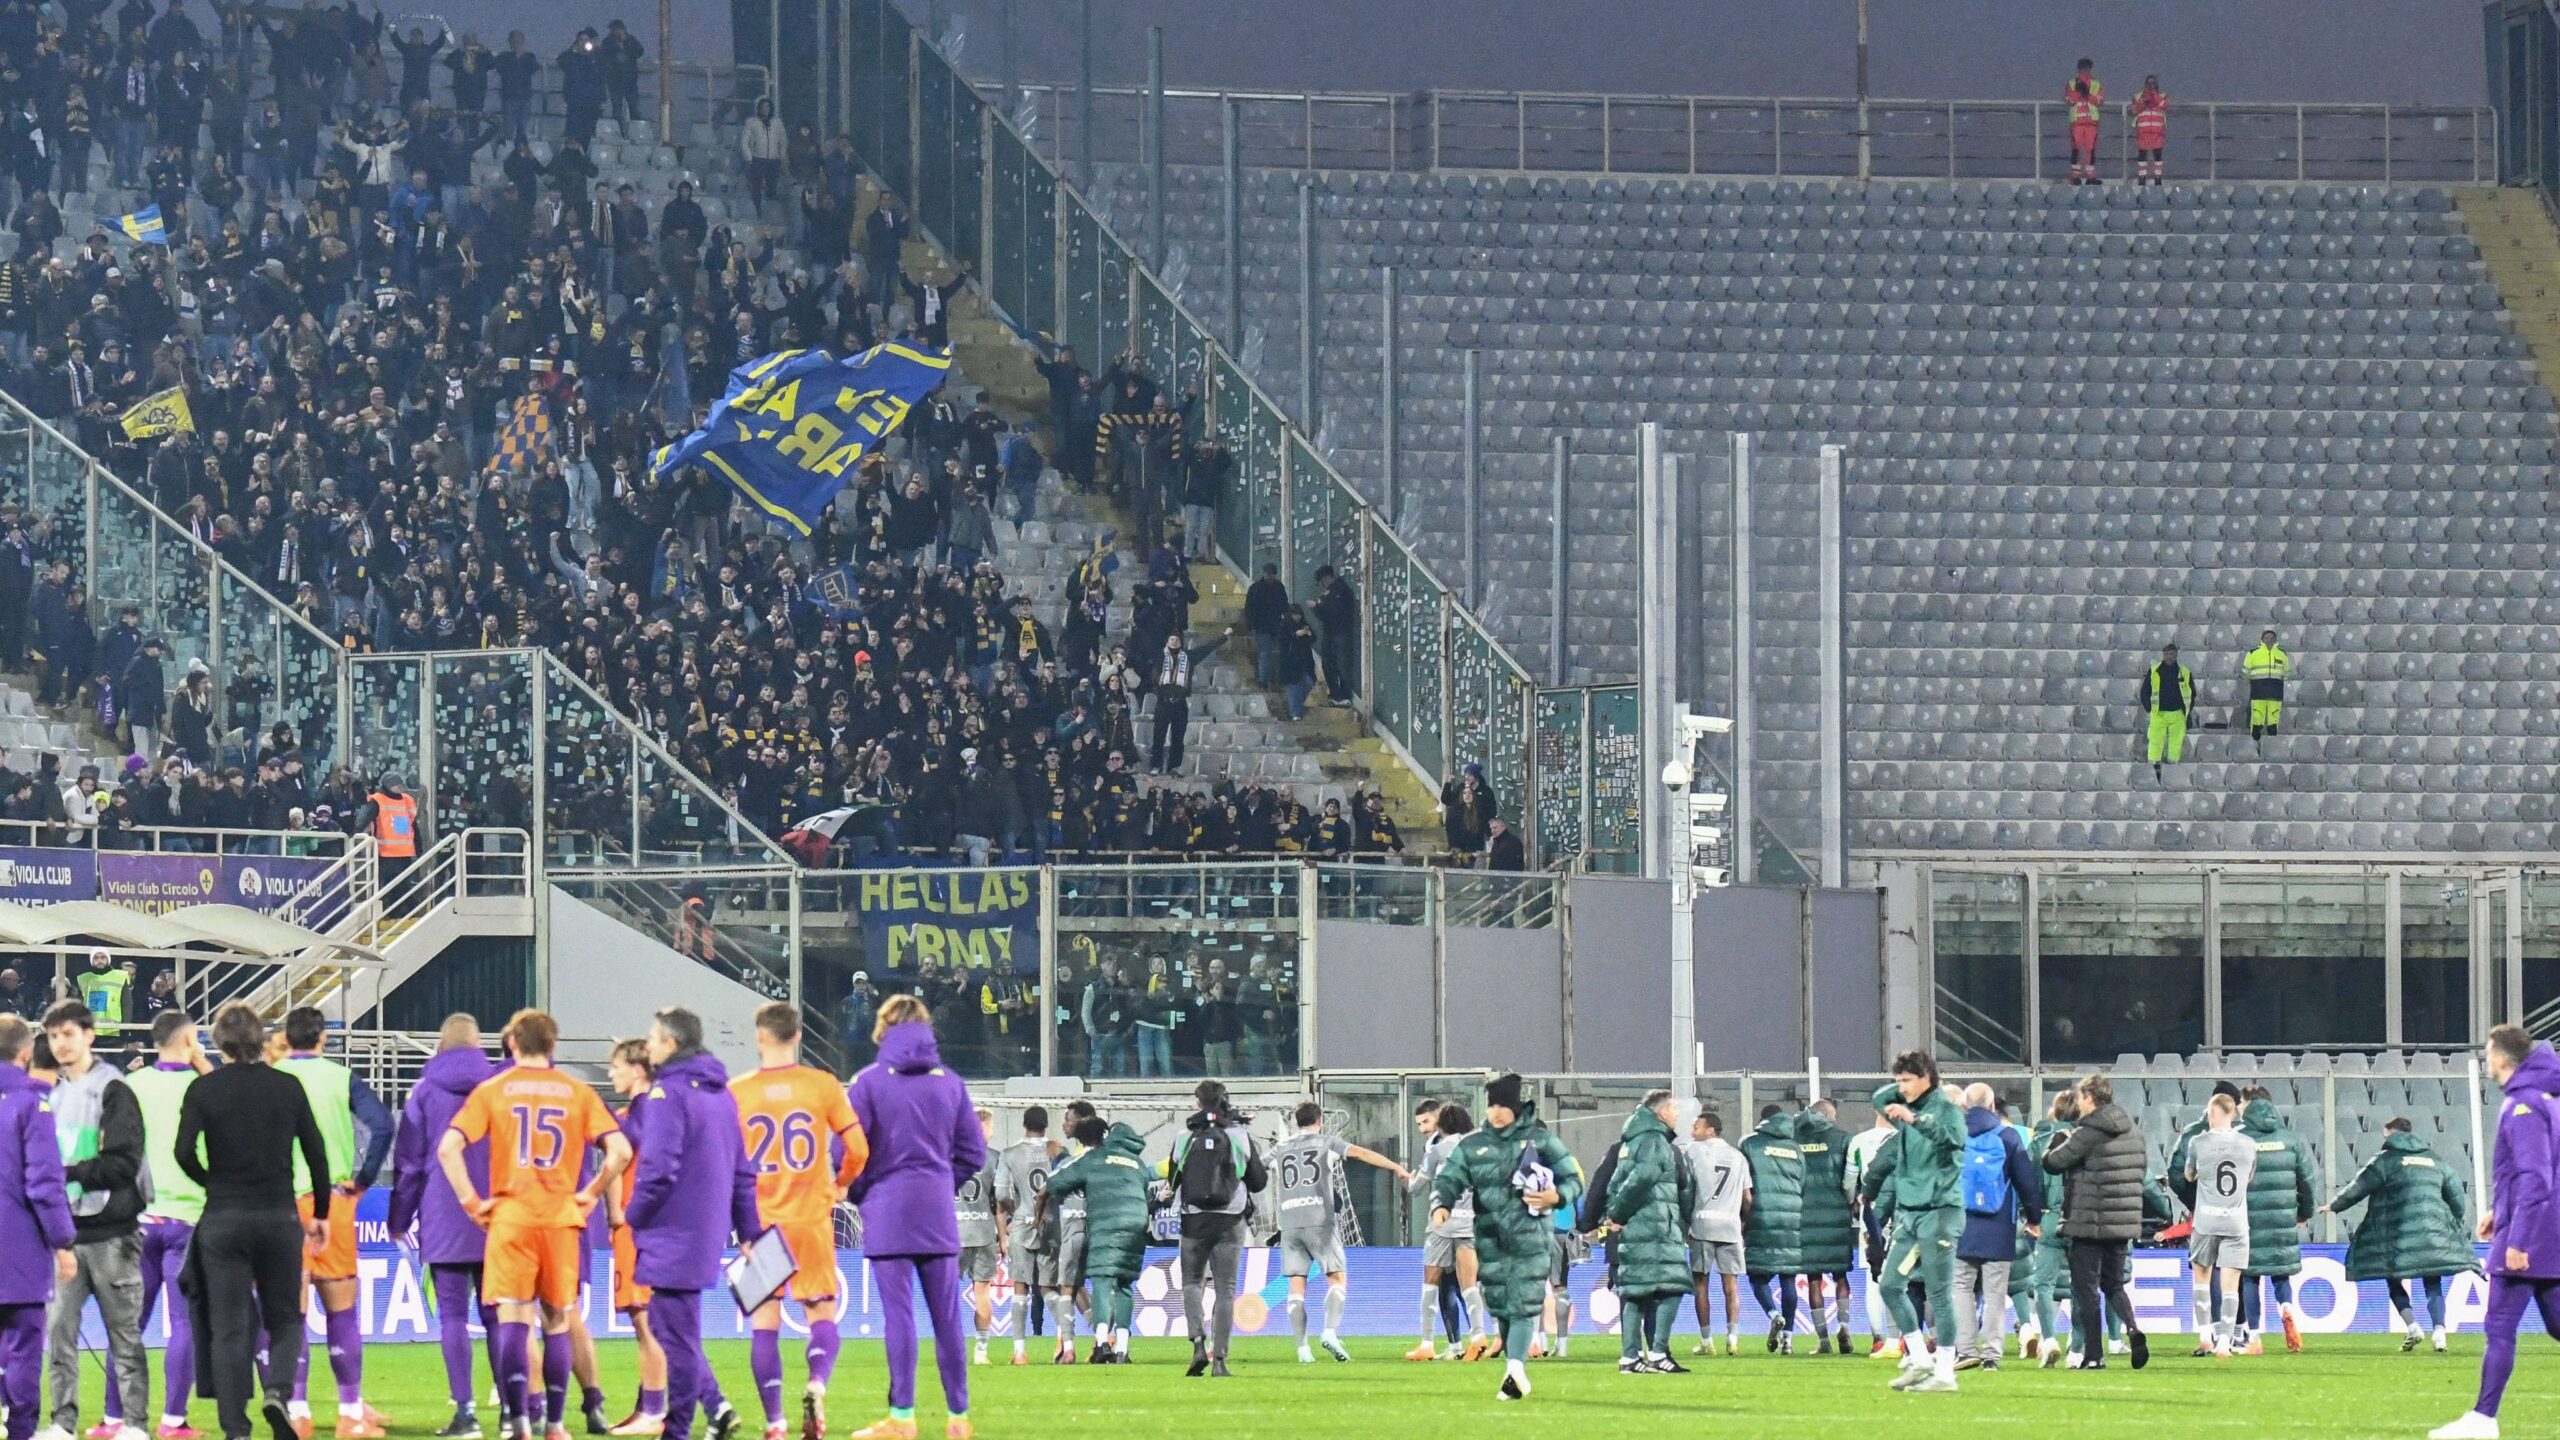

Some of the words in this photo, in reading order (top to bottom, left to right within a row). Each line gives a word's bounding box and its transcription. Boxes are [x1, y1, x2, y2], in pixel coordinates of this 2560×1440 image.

[16, 865, 45, 884] VIOLA
[46, 866, 72, 885] CLUB
[107, 881, 135, 894] Viola
[137, 882, 159, 895] Club
[161, 883, 199, 896] Circolo
[265, 878, 295, 896] VIOLA
[861, 868, 1029, 914] HELLAS
[511, 1103, 566, 1170] 15
[746, 1110, 816, 1173] 26
[1281, 1149, 1321, 1190] 63
[1712, 1165, 1731, 1200] 7
[2215, 1160, 2238, 1198] 6
[1157, 1220, 1179, 1236] 08
